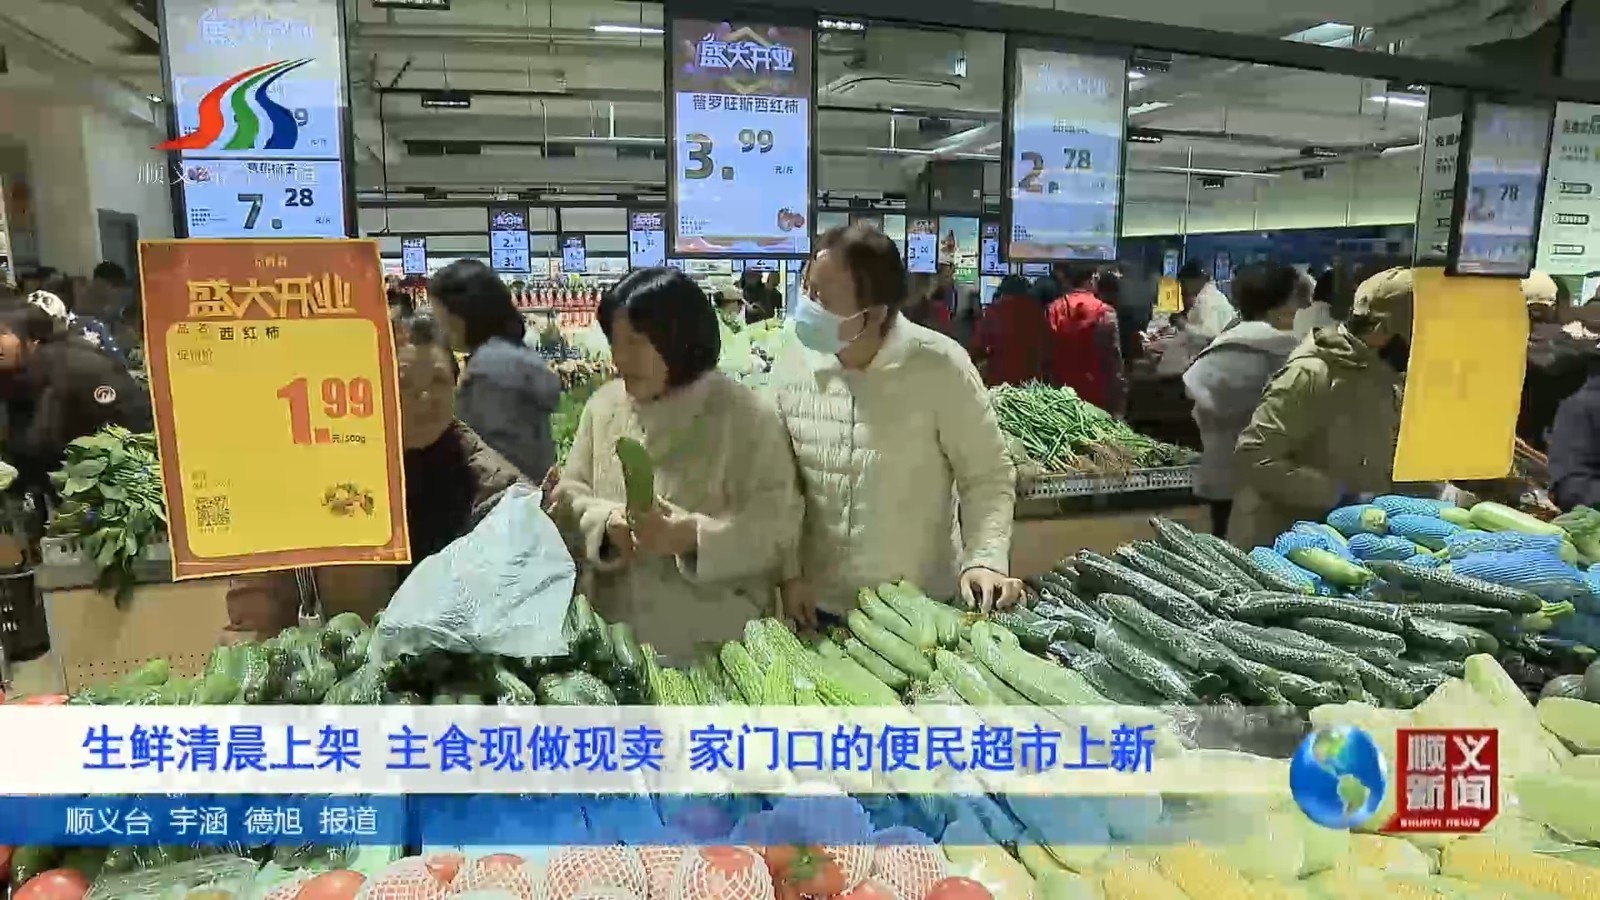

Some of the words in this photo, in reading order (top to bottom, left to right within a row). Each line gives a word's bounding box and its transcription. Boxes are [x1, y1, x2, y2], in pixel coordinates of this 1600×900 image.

[699, 34, 795, 74] 盛大开业
[693, 95, 799, 114] 普罗旺斯西红柿
[685, 129, 774, 180] 3.99
[237, 188, 314, 230] 7.28
[186, 272, 358, 319] 盛大开业
[219, 326, 280, 341] 西红柿
[276, 376, 374, 445] 1.99
